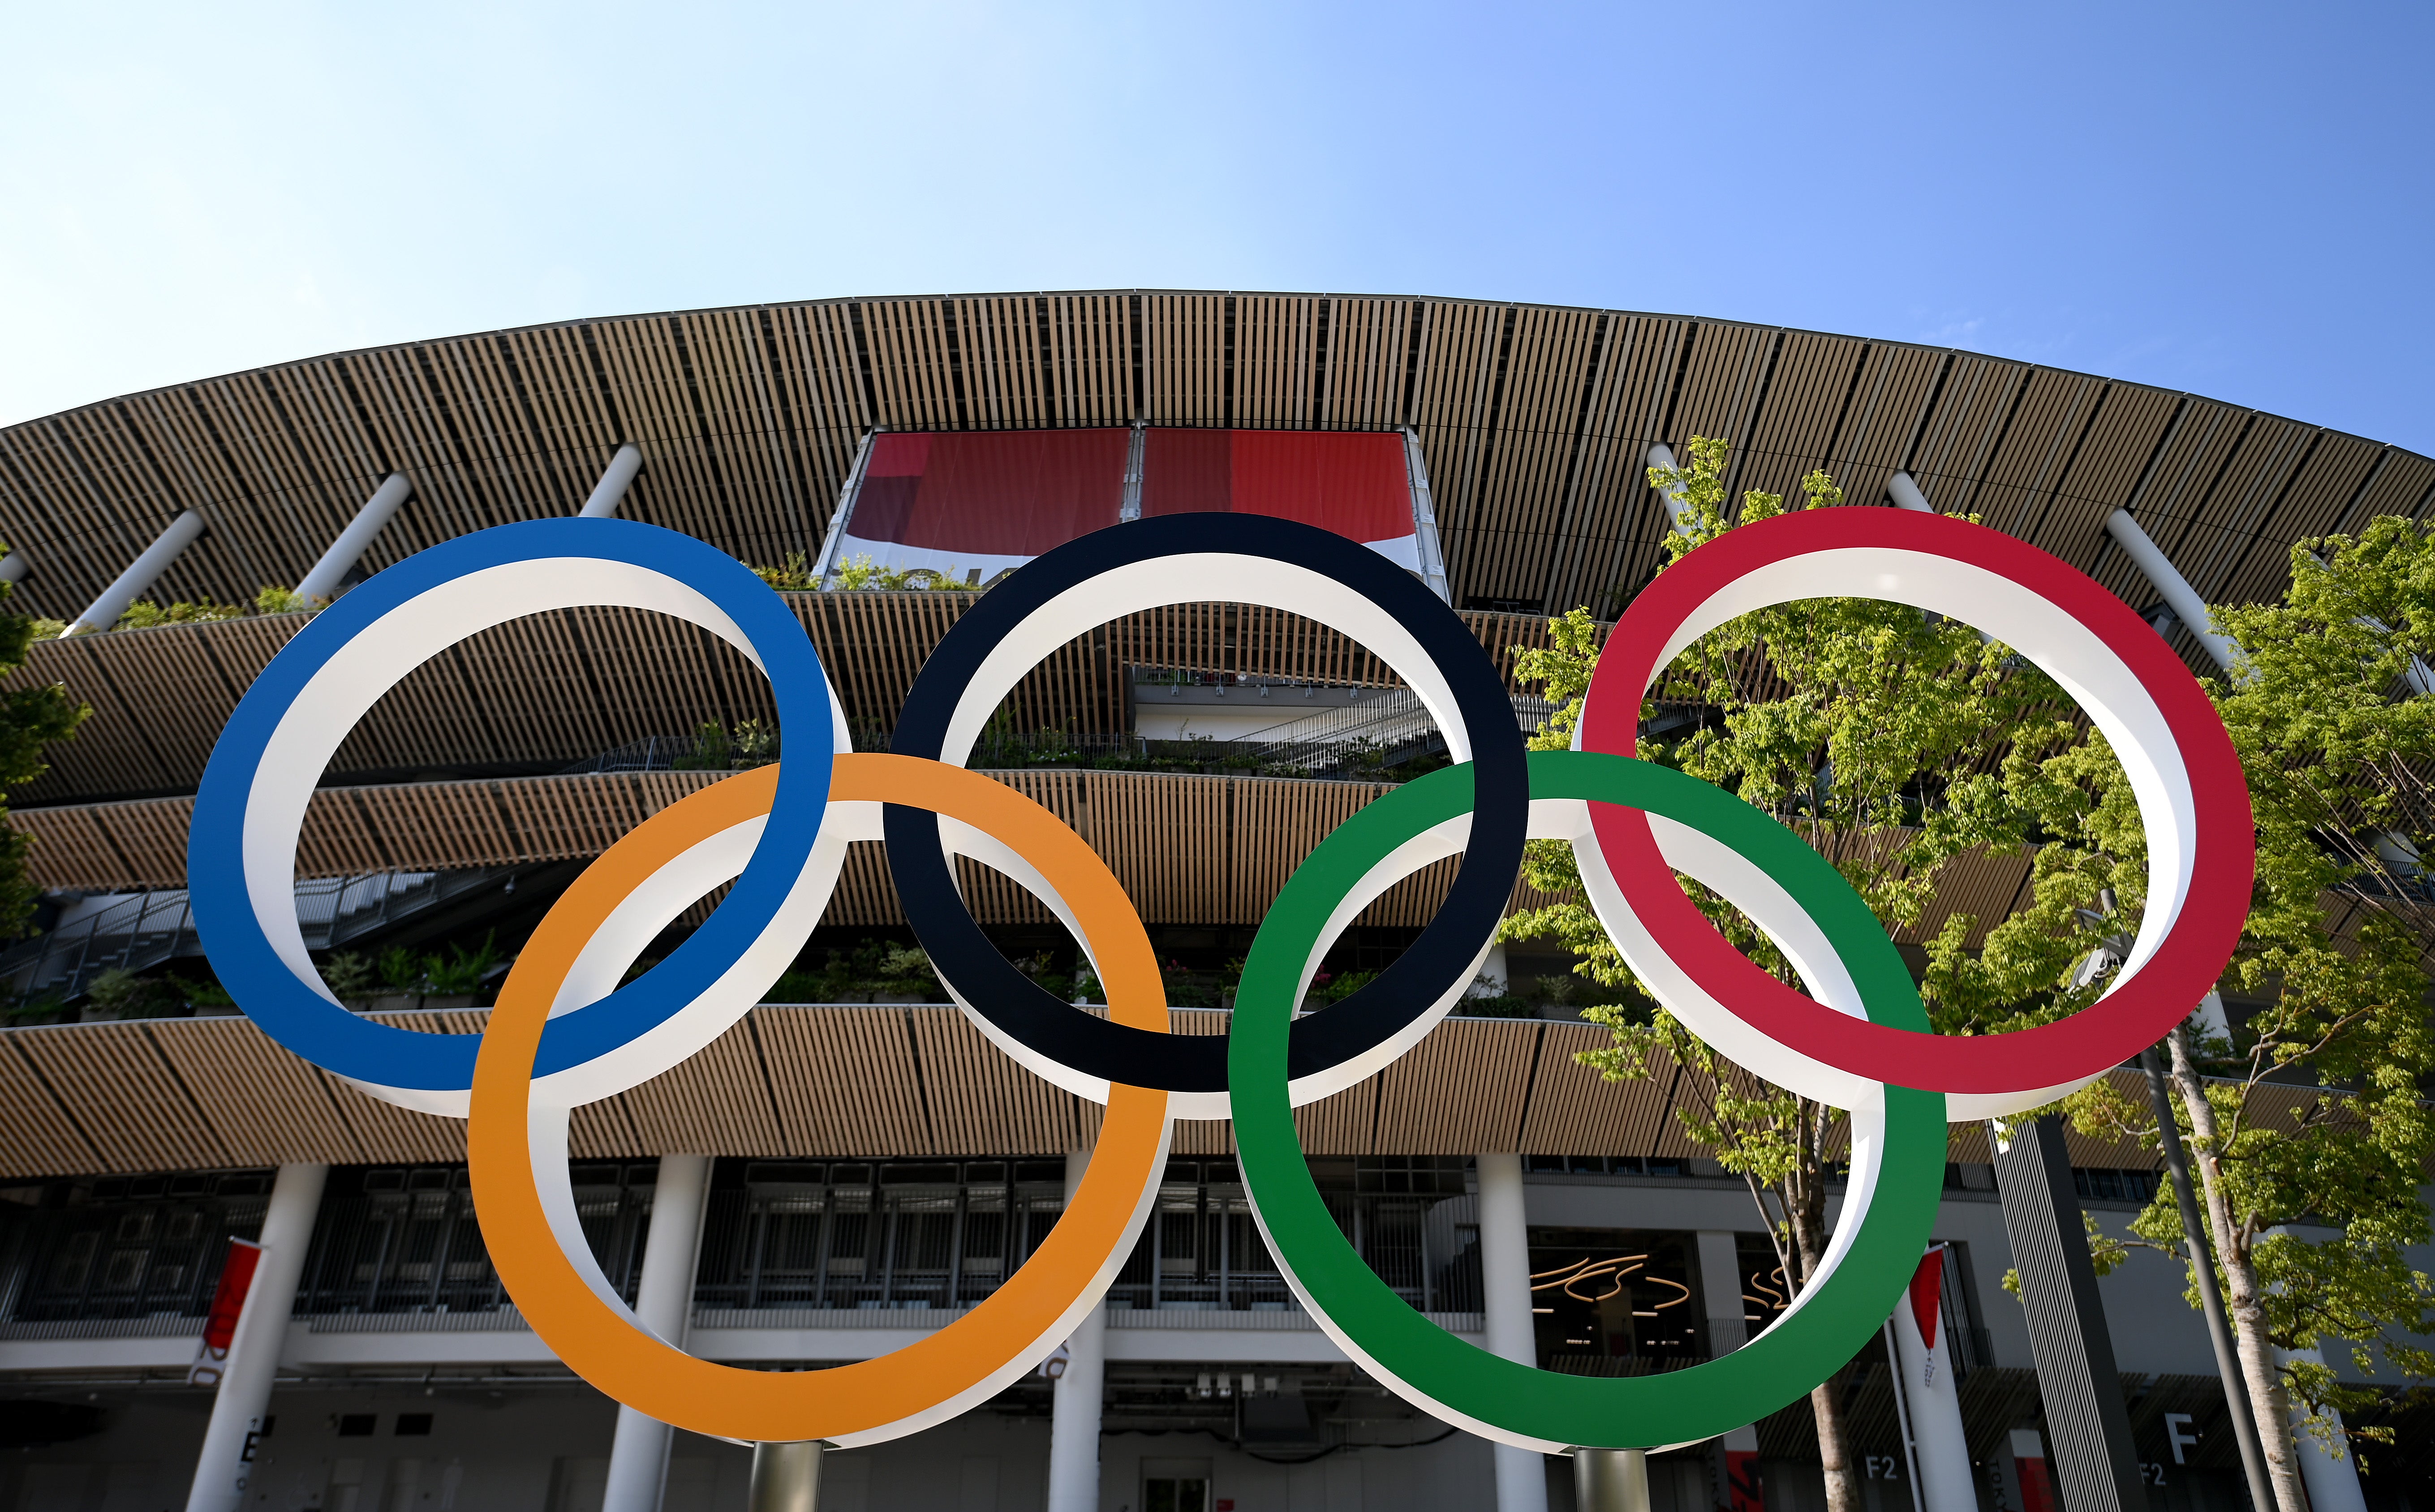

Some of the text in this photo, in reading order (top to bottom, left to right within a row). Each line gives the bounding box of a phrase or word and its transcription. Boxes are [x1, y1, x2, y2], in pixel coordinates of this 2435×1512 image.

[241, 1432, 262, 1461] E
[2164, 1413, 2197, 1465] F
[1866, 1456, 1897, 1479] F2
[2139, 1463, 2167, 1486] F2
